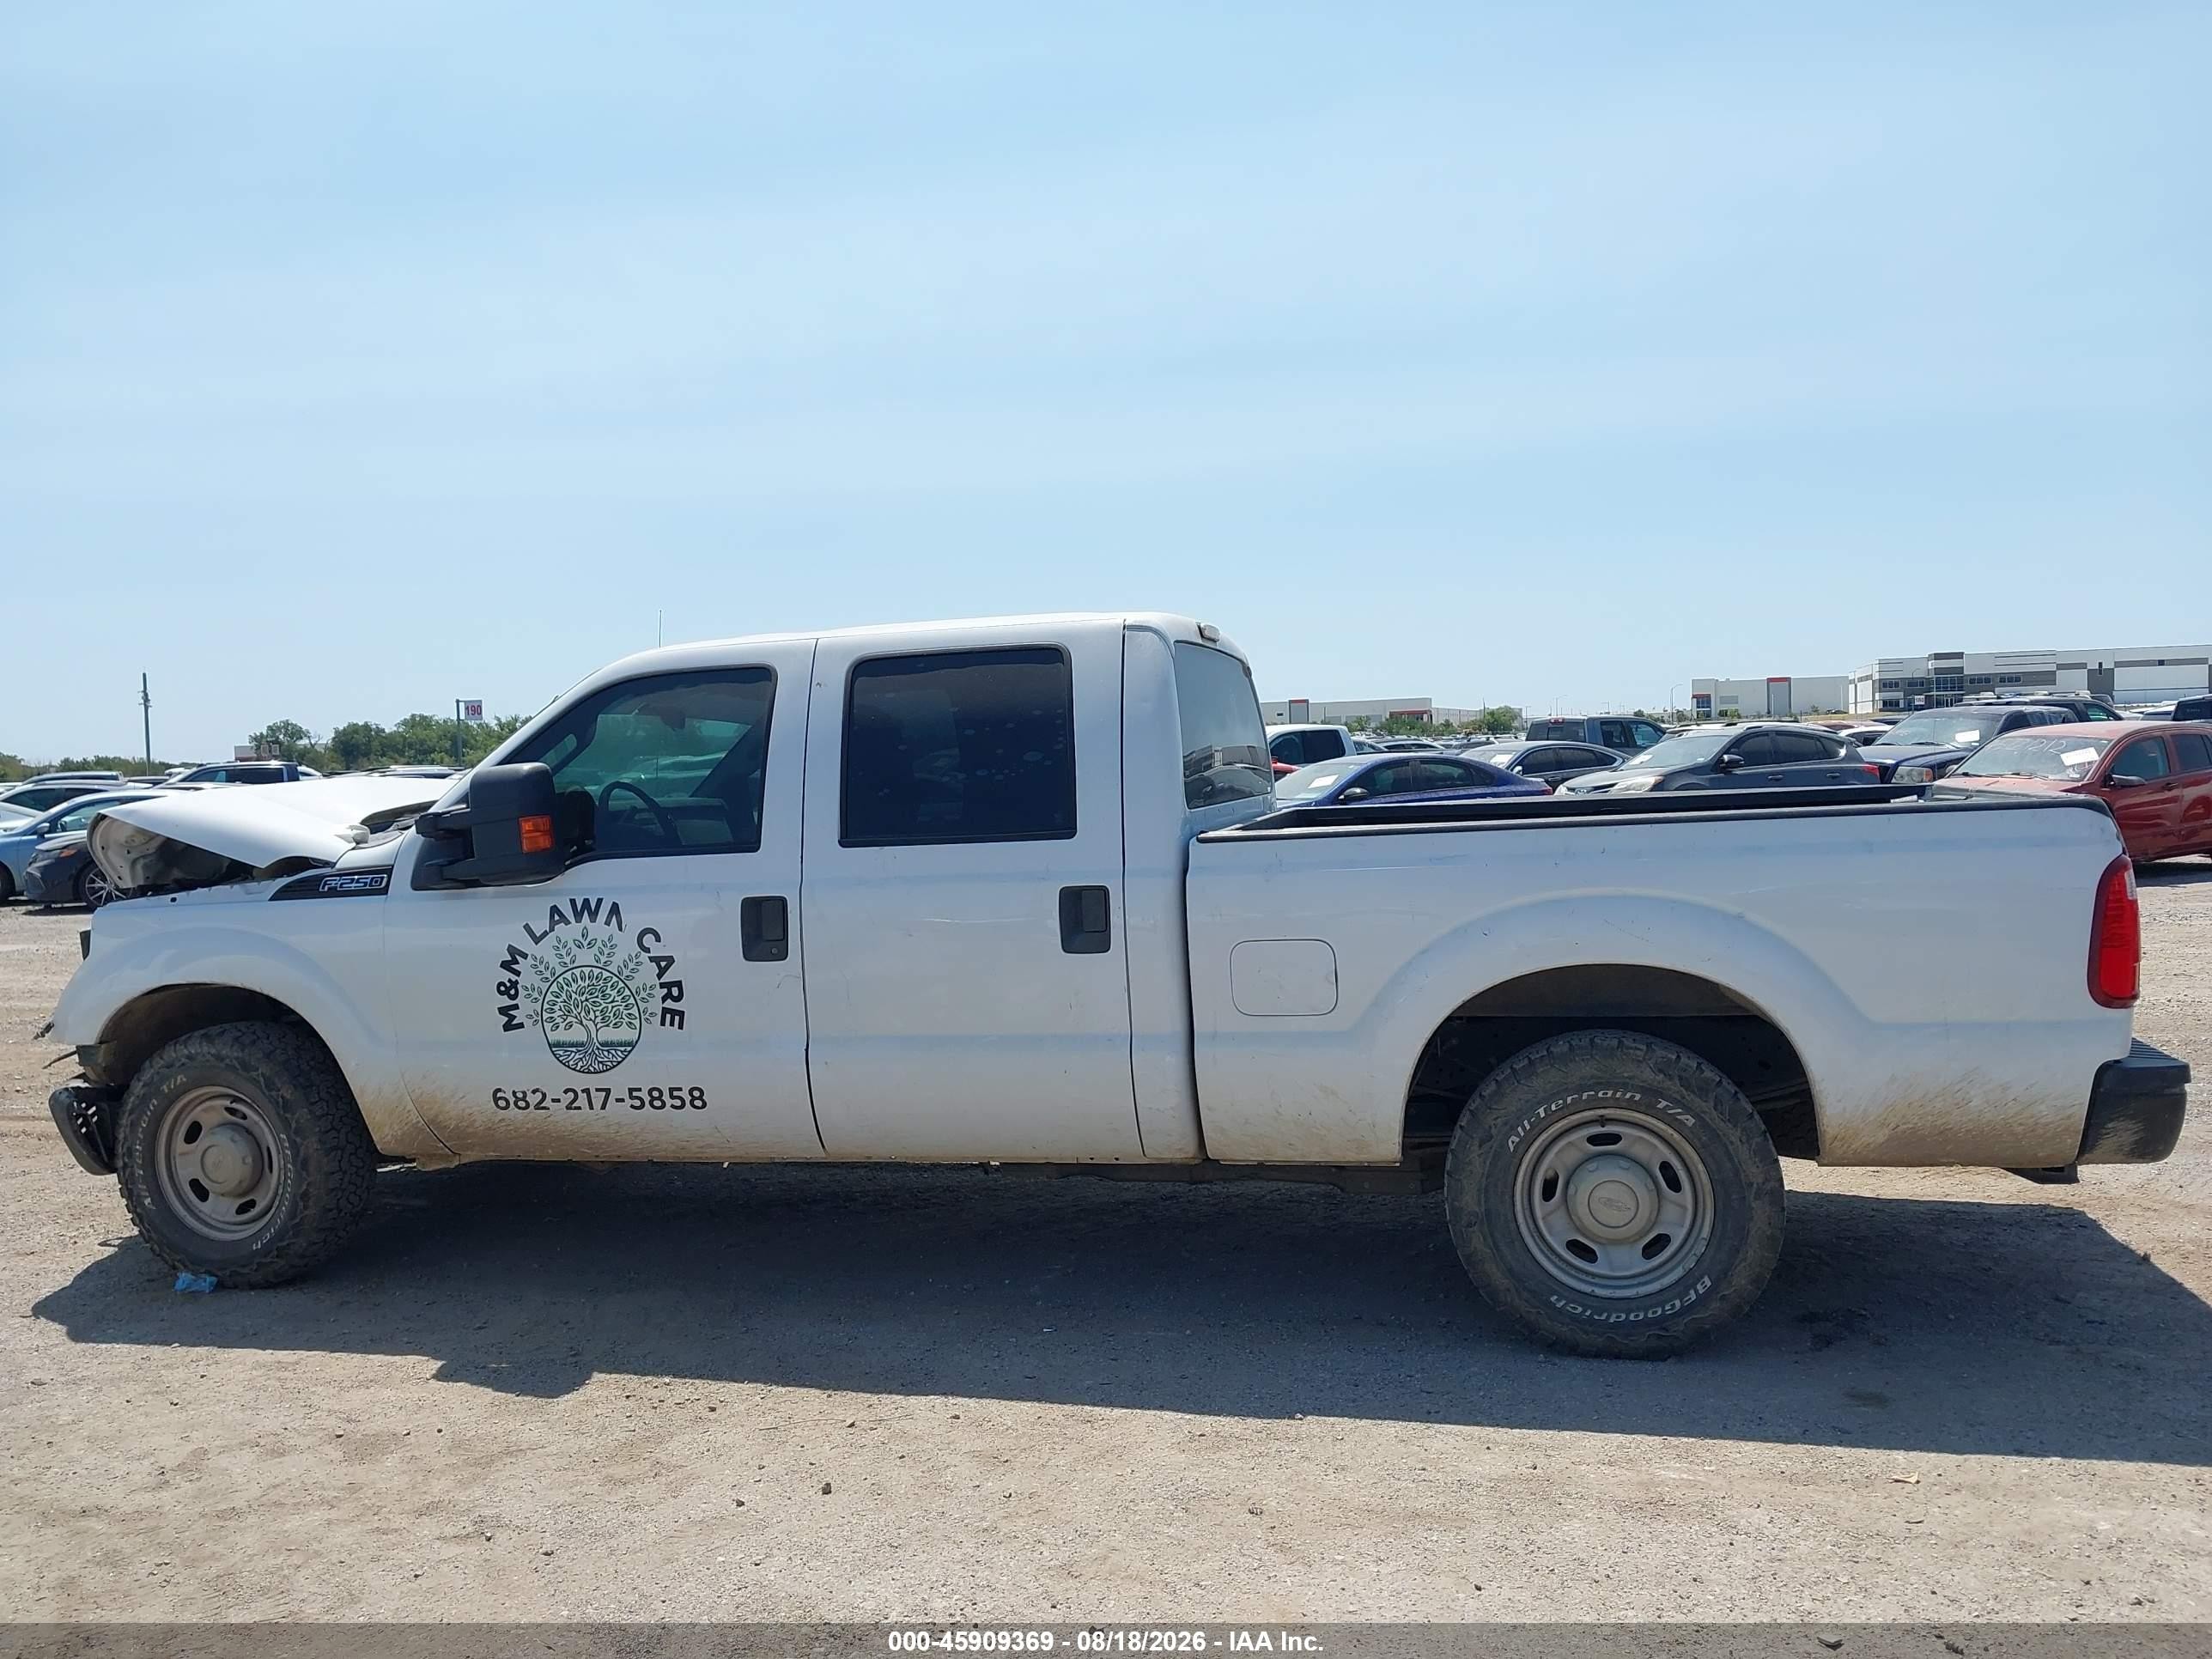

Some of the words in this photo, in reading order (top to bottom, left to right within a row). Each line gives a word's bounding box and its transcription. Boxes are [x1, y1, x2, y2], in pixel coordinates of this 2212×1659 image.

[465, 705, 483, 716] 190
[495, 944, 529, 1032] M&M
[636, 927, 685, 1030] CARE
[492, 1086, 708, 1111] 682-217-5858
[1507, 1088, 1642, 1153] All-Terrain
[1656, 1097, 1697, 1128] T/A
[1549, 1274, 1712, 1324] BFGoodrich
